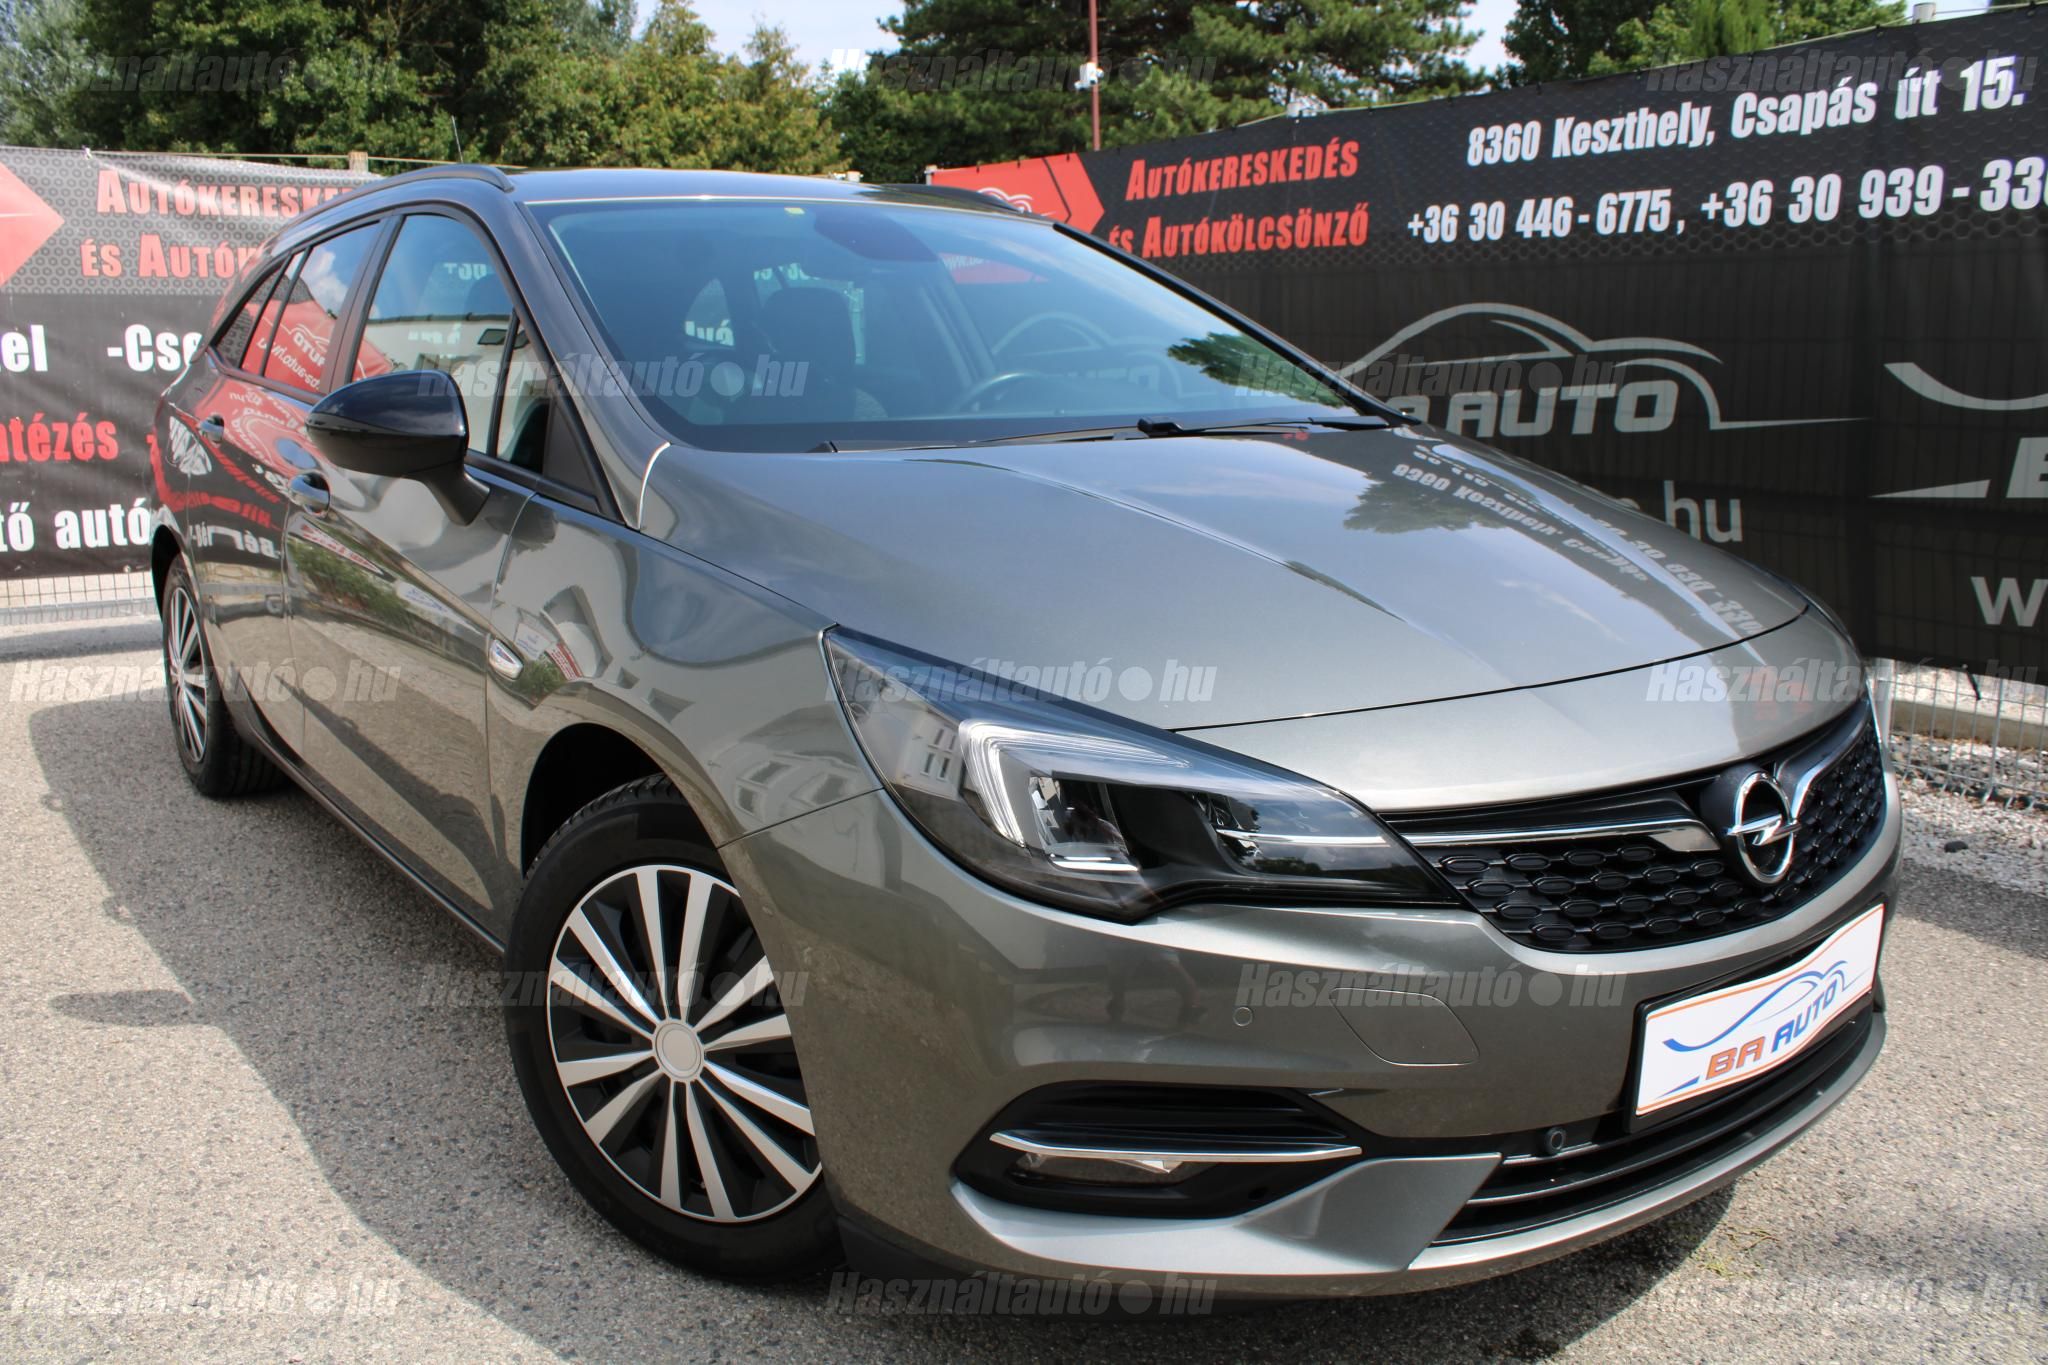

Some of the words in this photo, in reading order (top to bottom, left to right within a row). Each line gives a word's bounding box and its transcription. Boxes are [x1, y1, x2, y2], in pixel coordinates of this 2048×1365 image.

[1467, 120, 1541, 167] 8360
[1552, 101, 1715, 159] Keszthely,
[1730, 76, 1878, 139] Csapás
[1894, 67, 1942, 120] út
[1960, 55, 2025, 112] 15.
[1407, 204, 1460, 244] +36
[1468, 201, 1506, 241] 30
[1701, 180, 1774, 228] +36
[1788, 173, 1842, 224] 30
[1980, 156, 2048, 213] 33
[0, 324, 48, 372] el
[1445, 379, 1680, 438] AUTO
[55, 498, 152, 549] autó
[1706, 1036, 1766, 1081] BA
[1771, 979, 1838, 1053] AUTO
